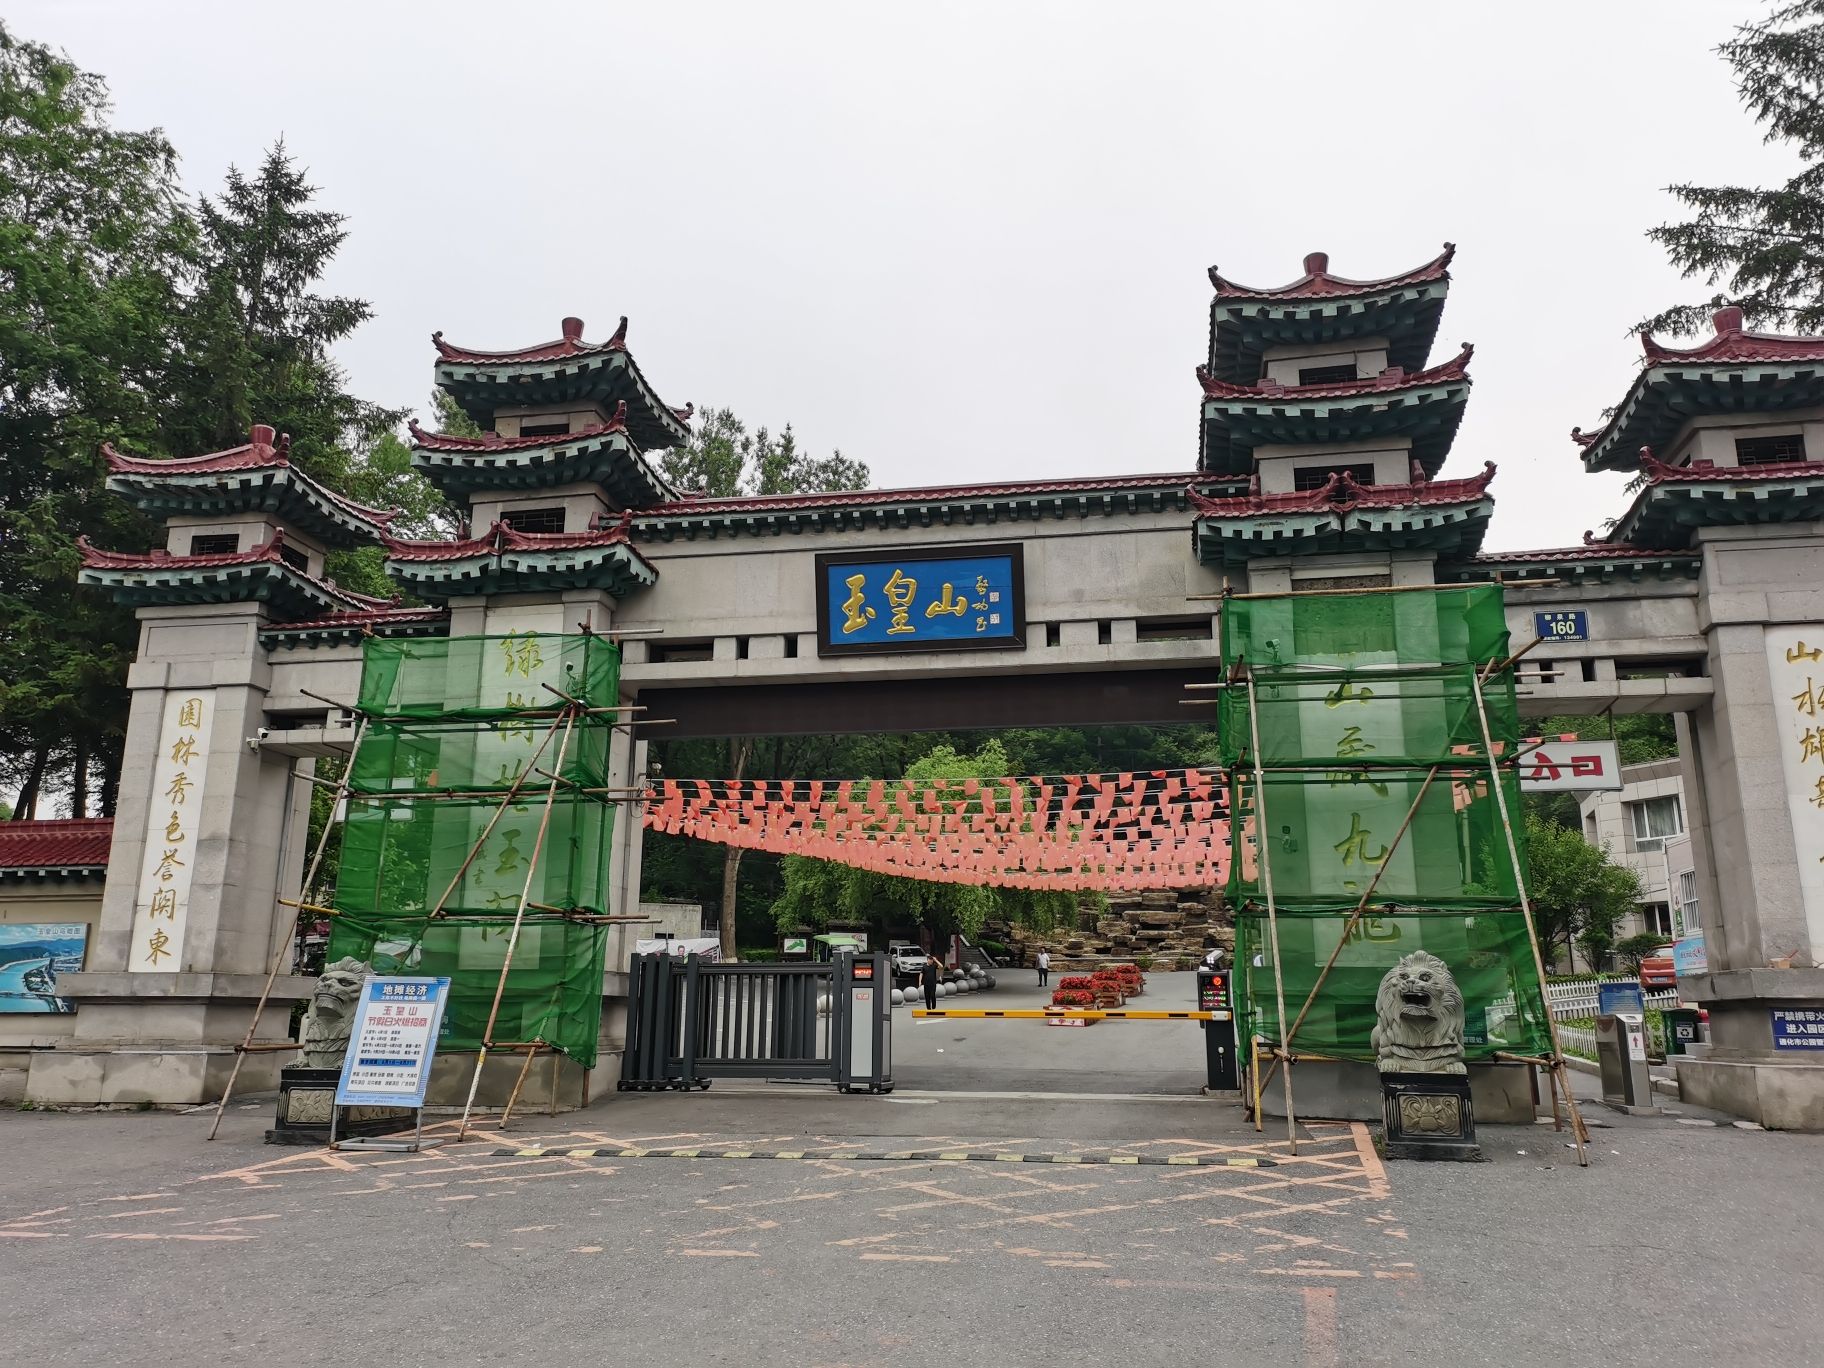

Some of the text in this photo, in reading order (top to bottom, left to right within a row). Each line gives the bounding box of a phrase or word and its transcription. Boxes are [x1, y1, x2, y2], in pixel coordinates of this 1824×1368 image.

[842, 569, 968, 634] 玉皇山
[1550, 621, 1575, 634] 160
[383, 984, 428, 996] 地摊经济
[382, 1005, 418, 1016] 玉皇山
